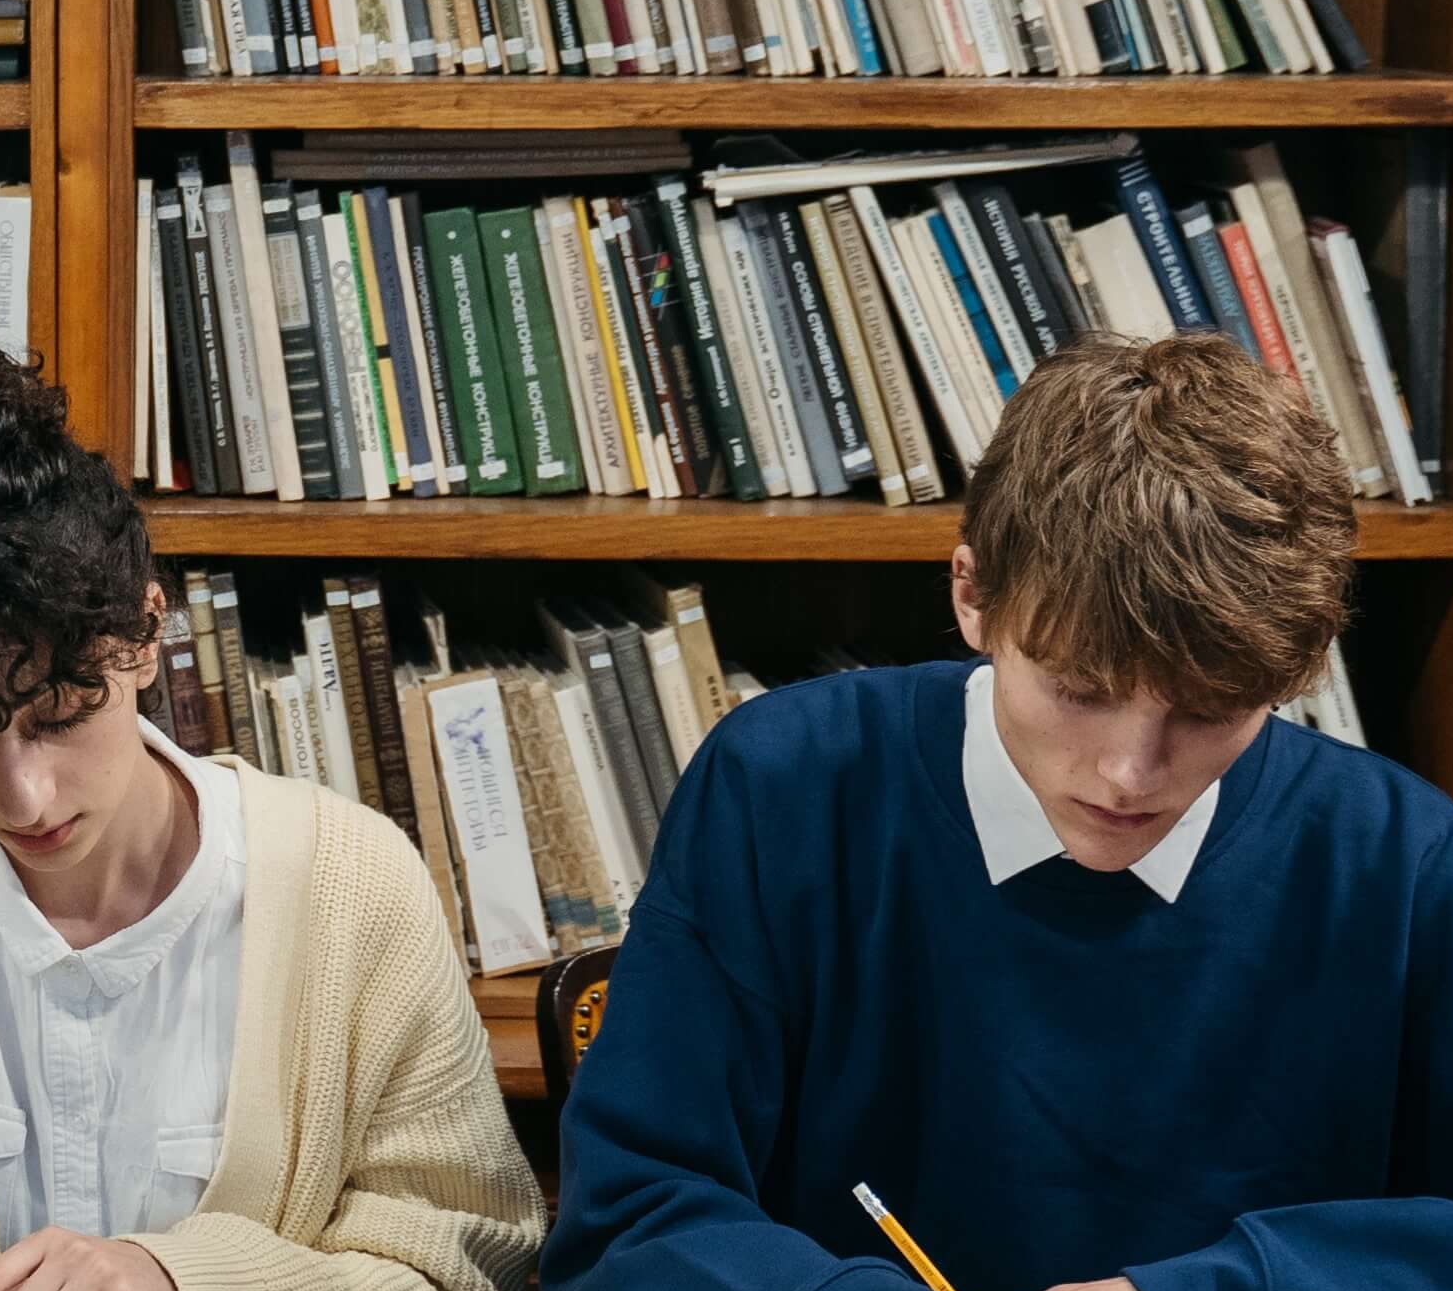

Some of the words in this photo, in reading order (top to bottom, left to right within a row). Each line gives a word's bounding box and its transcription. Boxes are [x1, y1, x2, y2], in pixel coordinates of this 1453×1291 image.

[449, 253, 481, 378] ЖЕЛЕЗОБЕТОННЫЕ
[503, 251, 537, 376] ЖЕЛЕЗОБЕТОННЫЕ
[561, 230, 595, 343] КОНСТРУКЦИИ
[687, 278, 714, 339] История
[836, 218, 870, 291] ВВЕДЕНИЕ
[862, 305, 909, 416] СТРОИТЕЛЬНУЮ
[982, 198, 1021, 262] ИСТОРИЯ
[1009, 260, 1048, 323] РУССКОЙ
[1134, 188, 1204, 325] СТРОИТЕЛЬНЫЕ
[584, 351, 621, 470] АРХИТЕКТУРНЫЕ
[285, 695, 312, 770] ГОЛОСОВ
